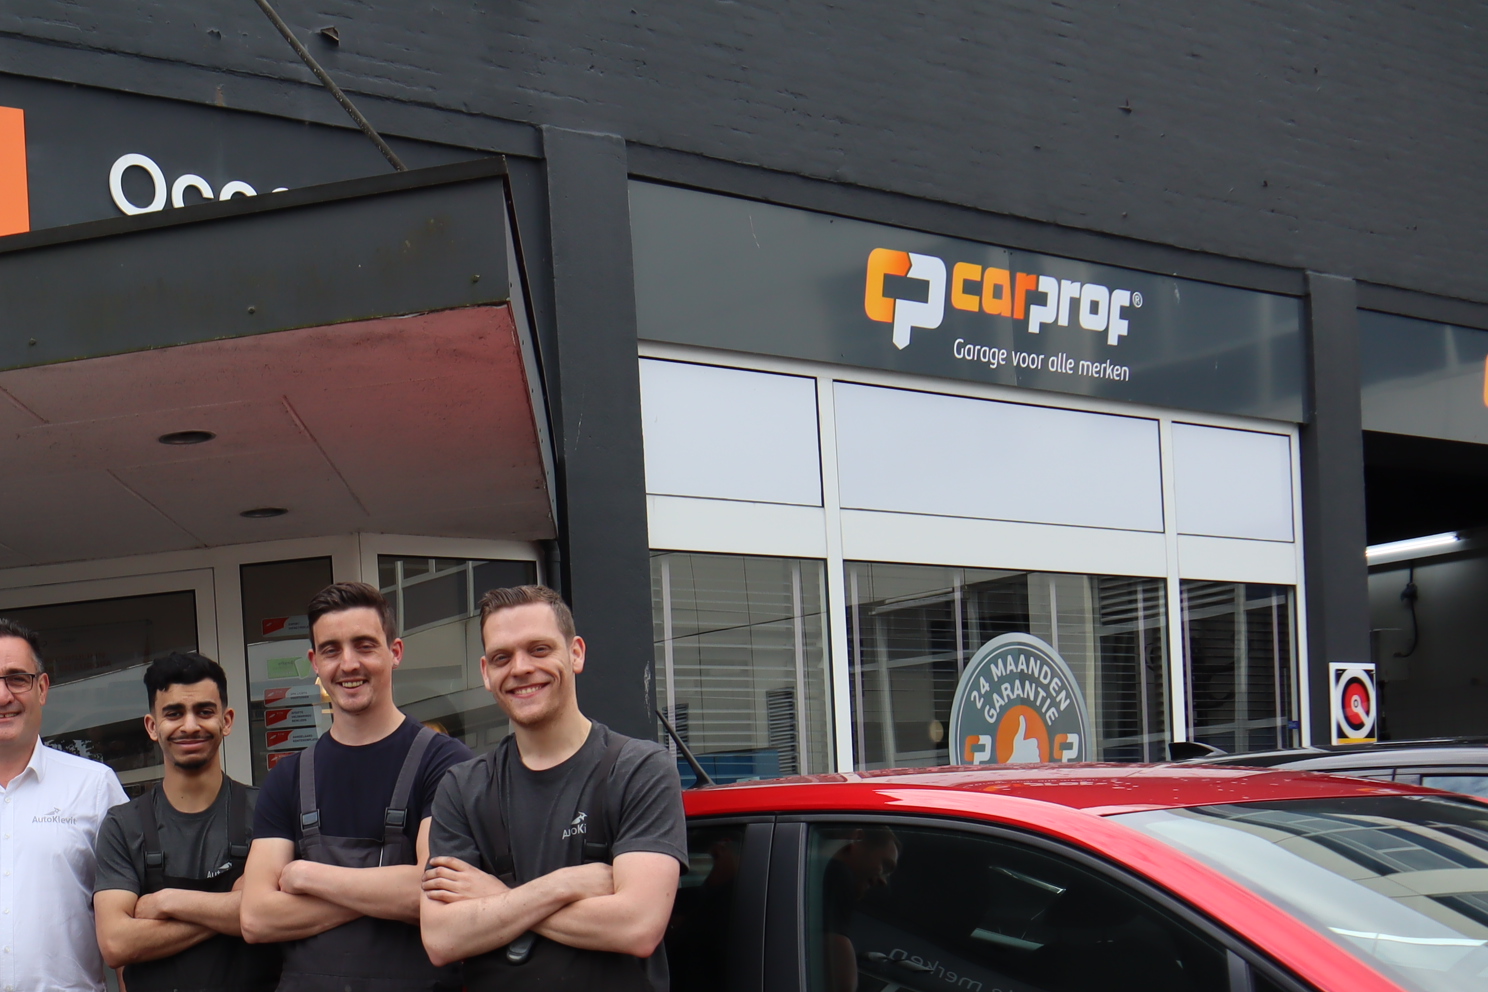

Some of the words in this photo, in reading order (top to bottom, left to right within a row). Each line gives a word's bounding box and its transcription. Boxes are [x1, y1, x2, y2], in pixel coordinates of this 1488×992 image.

[953, 338, 1007, 368] Garage
[1012, 350, 1045, 370] voor
[1048, 353, 1074, 375] alle
[1078, 358, 1130, 381] merken
[971, 676, 990, 710] 24
[990, 653, 1071, 711] MAANDEN
[984, 679, 1059, 726] GARANTIE
[32, 815, 76, 825] AutoKievit
